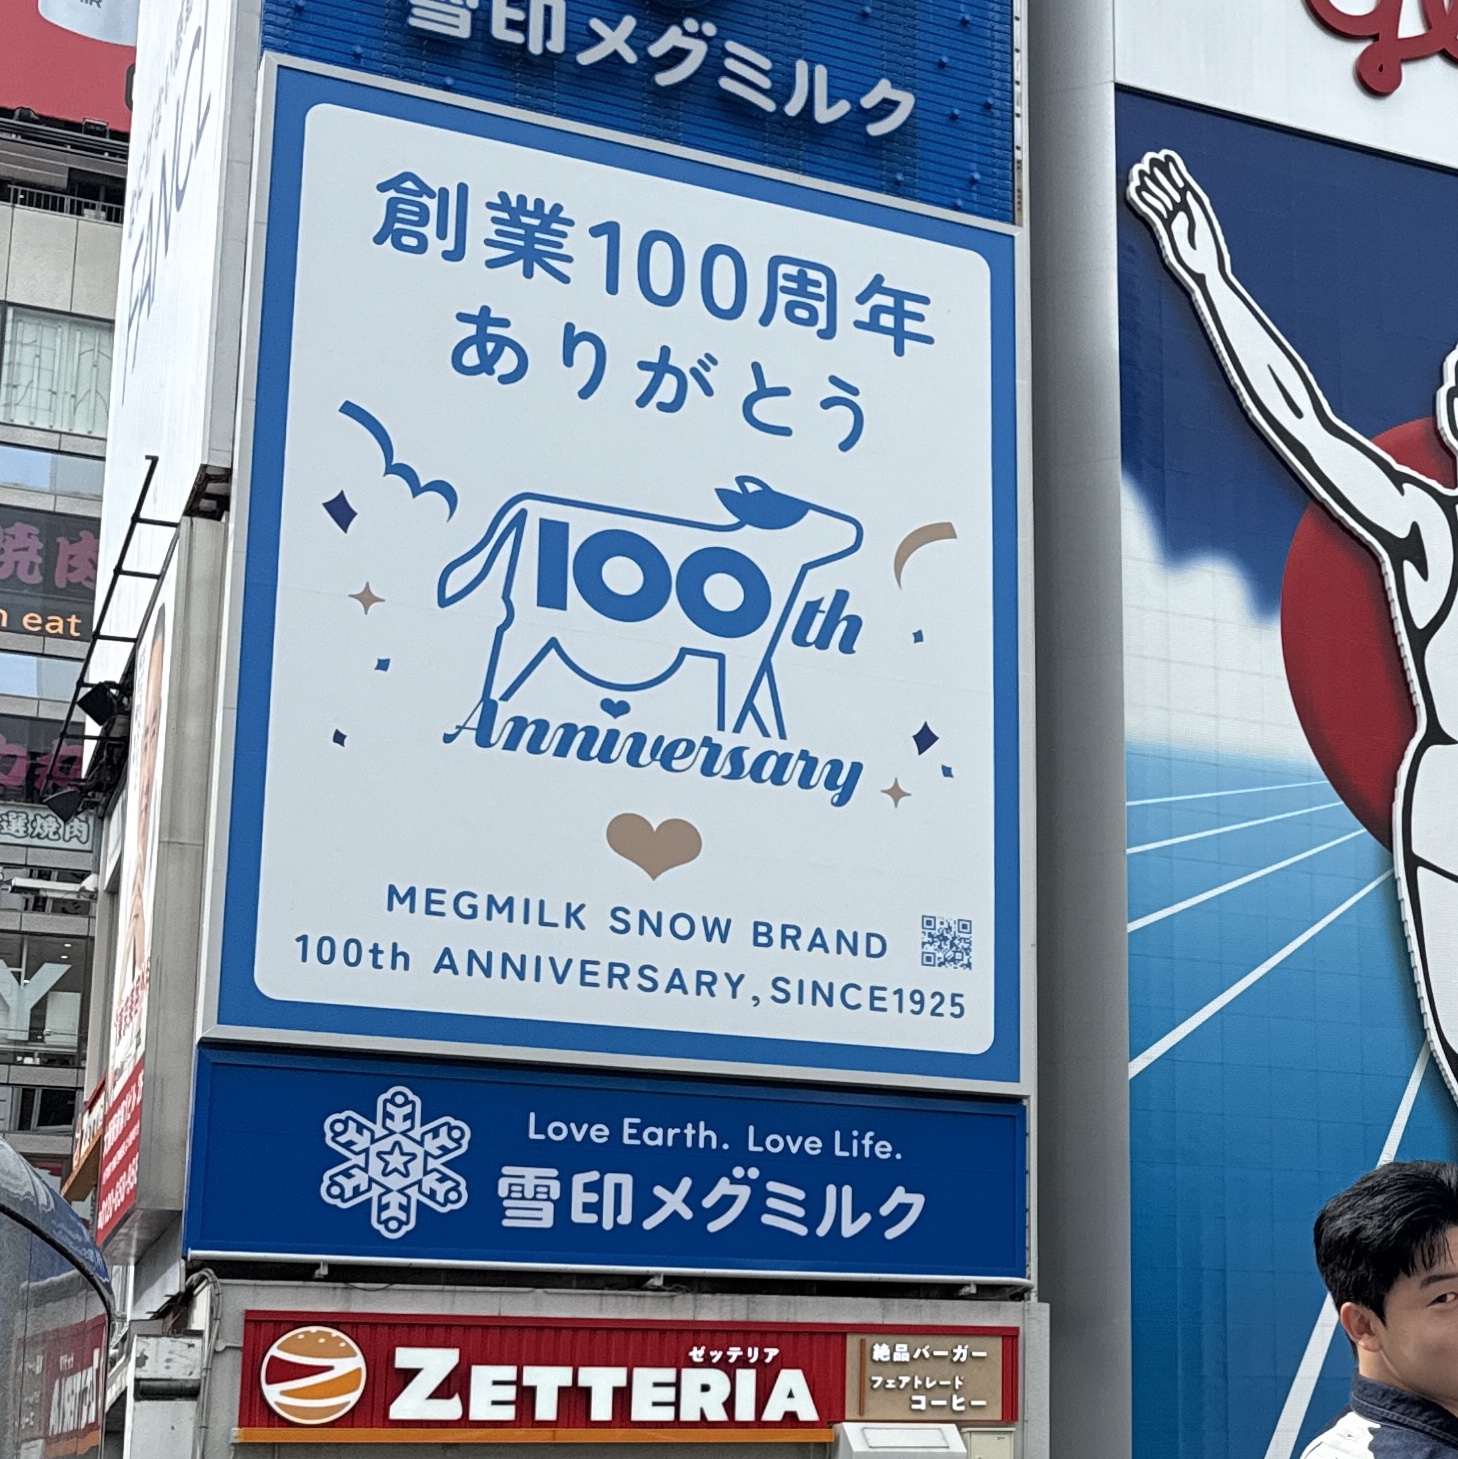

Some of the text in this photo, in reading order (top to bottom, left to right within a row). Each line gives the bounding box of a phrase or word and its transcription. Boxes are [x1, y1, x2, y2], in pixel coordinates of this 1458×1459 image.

[407, 0, 917, 136] 雪印メグミルク
[372, 170, 935, 357] 創業100周年
[450, 305, 865, 453] ありがとう
[22, 612, 82, 637] eat
[442, 698, 865, 807] Anniversary
[387, 883, 889, 959] MEGMILK SNOW BRAND
[295, 933, 411, 973] 100th
[528, 1111, 903, 1161] Love Earth. Love Life.
[498, 1165, 927, 1241] 雪印メグミルク
[388, 1346, 821, 1422] ZETTERIA
[688, 1346, 780, 1364] ゼッテリア
[870, 1374, 965, 1390] フェアトレード
[872, 1343, 988, 1363] 絶品バーガー
[910, 1394, 988, 1412] コーヒー
